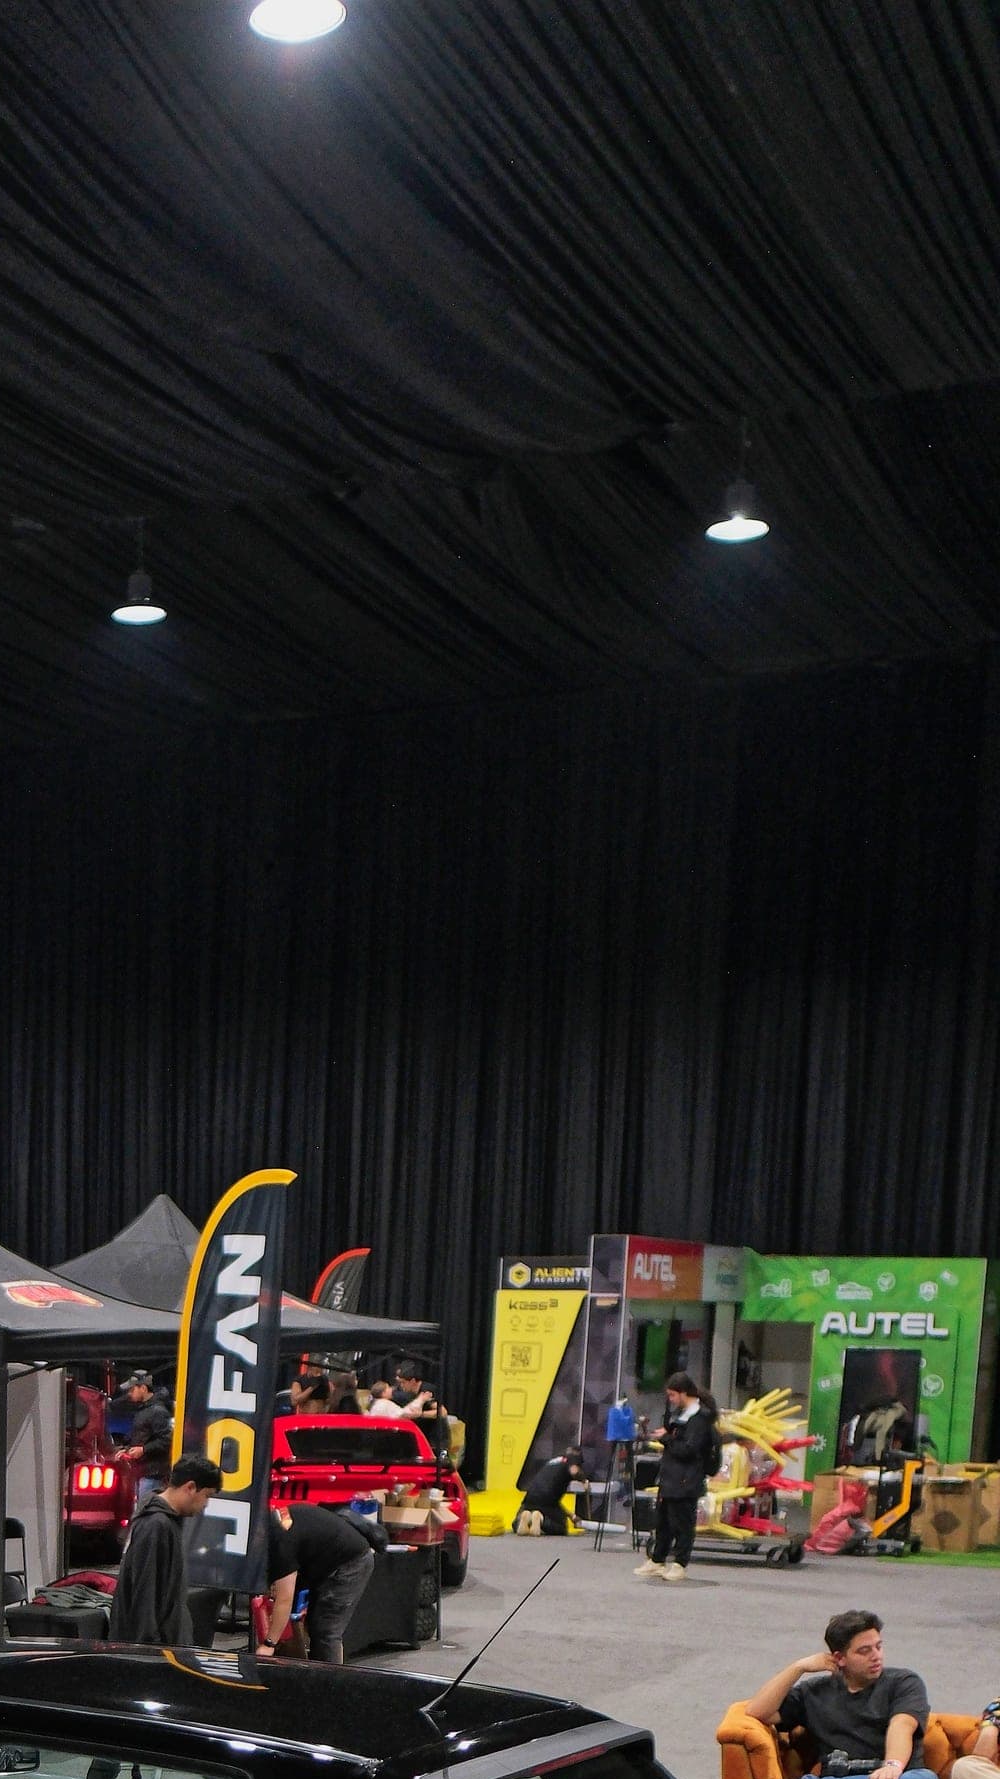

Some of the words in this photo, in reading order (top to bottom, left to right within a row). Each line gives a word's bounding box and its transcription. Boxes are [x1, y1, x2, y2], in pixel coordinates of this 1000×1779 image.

[632, 1251, 677, 1282] AUTEL
[820, 1311, 949, 1337] AUTEL
[203, 1234, 266, 1556] JOFAN
